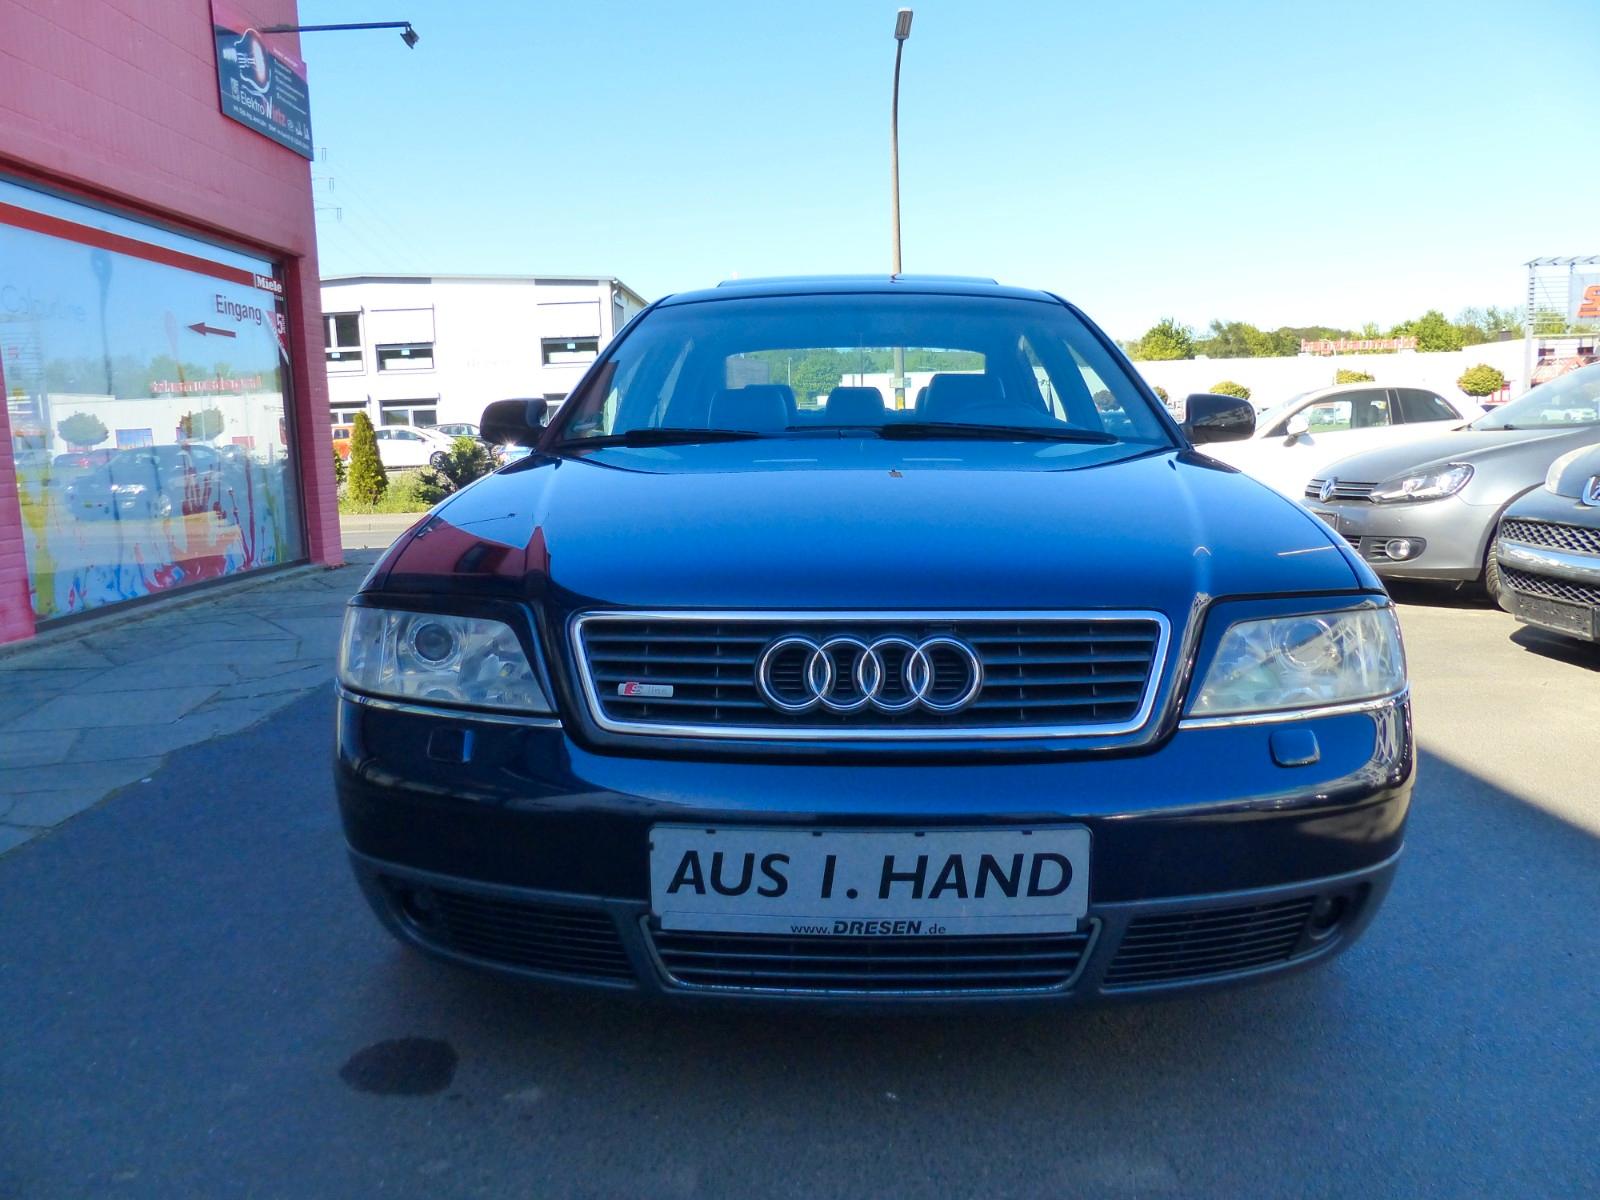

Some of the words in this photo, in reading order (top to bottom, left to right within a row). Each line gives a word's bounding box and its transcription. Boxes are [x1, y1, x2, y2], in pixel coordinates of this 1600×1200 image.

[256, 276, 282, 293] Miele
[215, 293, 262, 326] Eingang
[667, 850, 790, 897] AUS
[878, 852, 1073, 899] HAND
[791, 920, 946, 935] www.DRESEN.de
